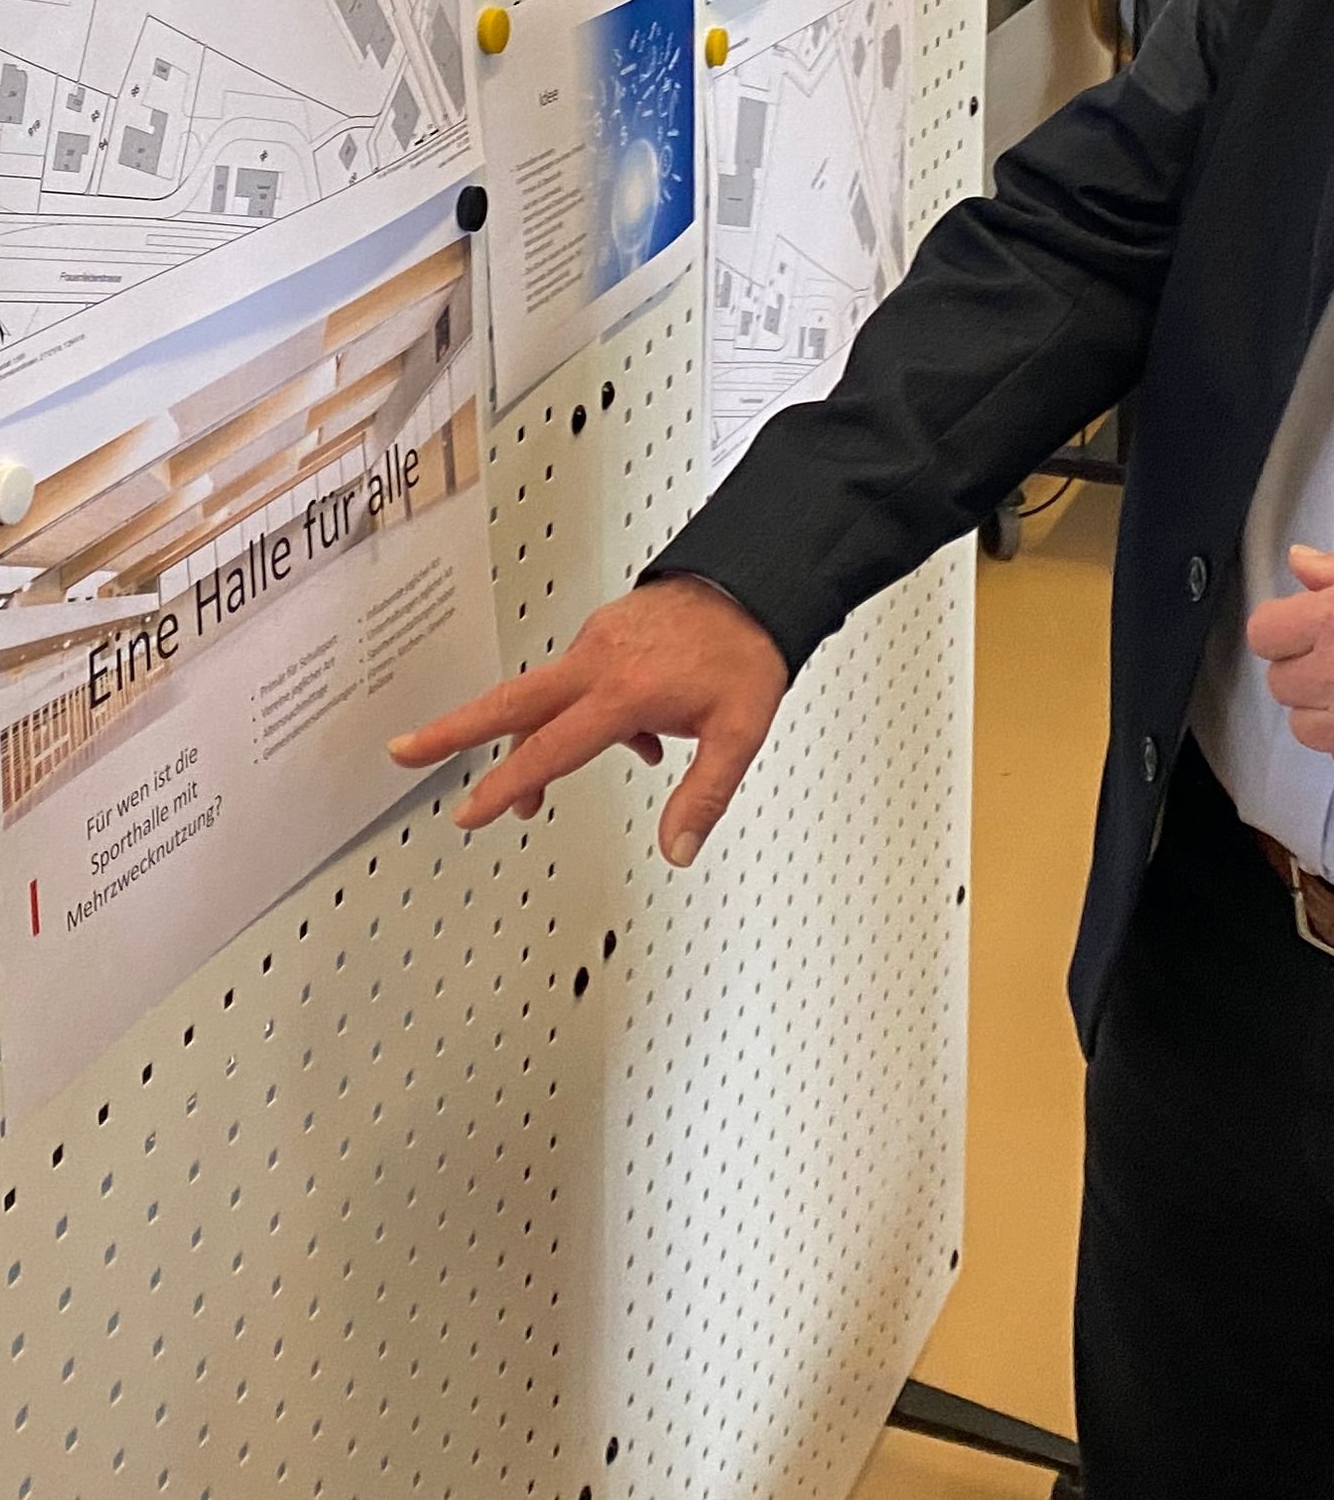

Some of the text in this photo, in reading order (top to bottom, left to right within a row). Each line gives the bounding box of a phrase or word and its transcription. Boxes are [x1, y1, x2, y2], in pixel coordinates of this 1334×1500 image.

[538, 88, 559, 107] Idee
[88, 443, 420, 710] Eine Halle für alle
[86, 746, 199, 841] Für wen ist die
[90, 781, 198, 876] Sporthalle mit
[66, 794, 224, 933] Mehrzwecknutzung?
